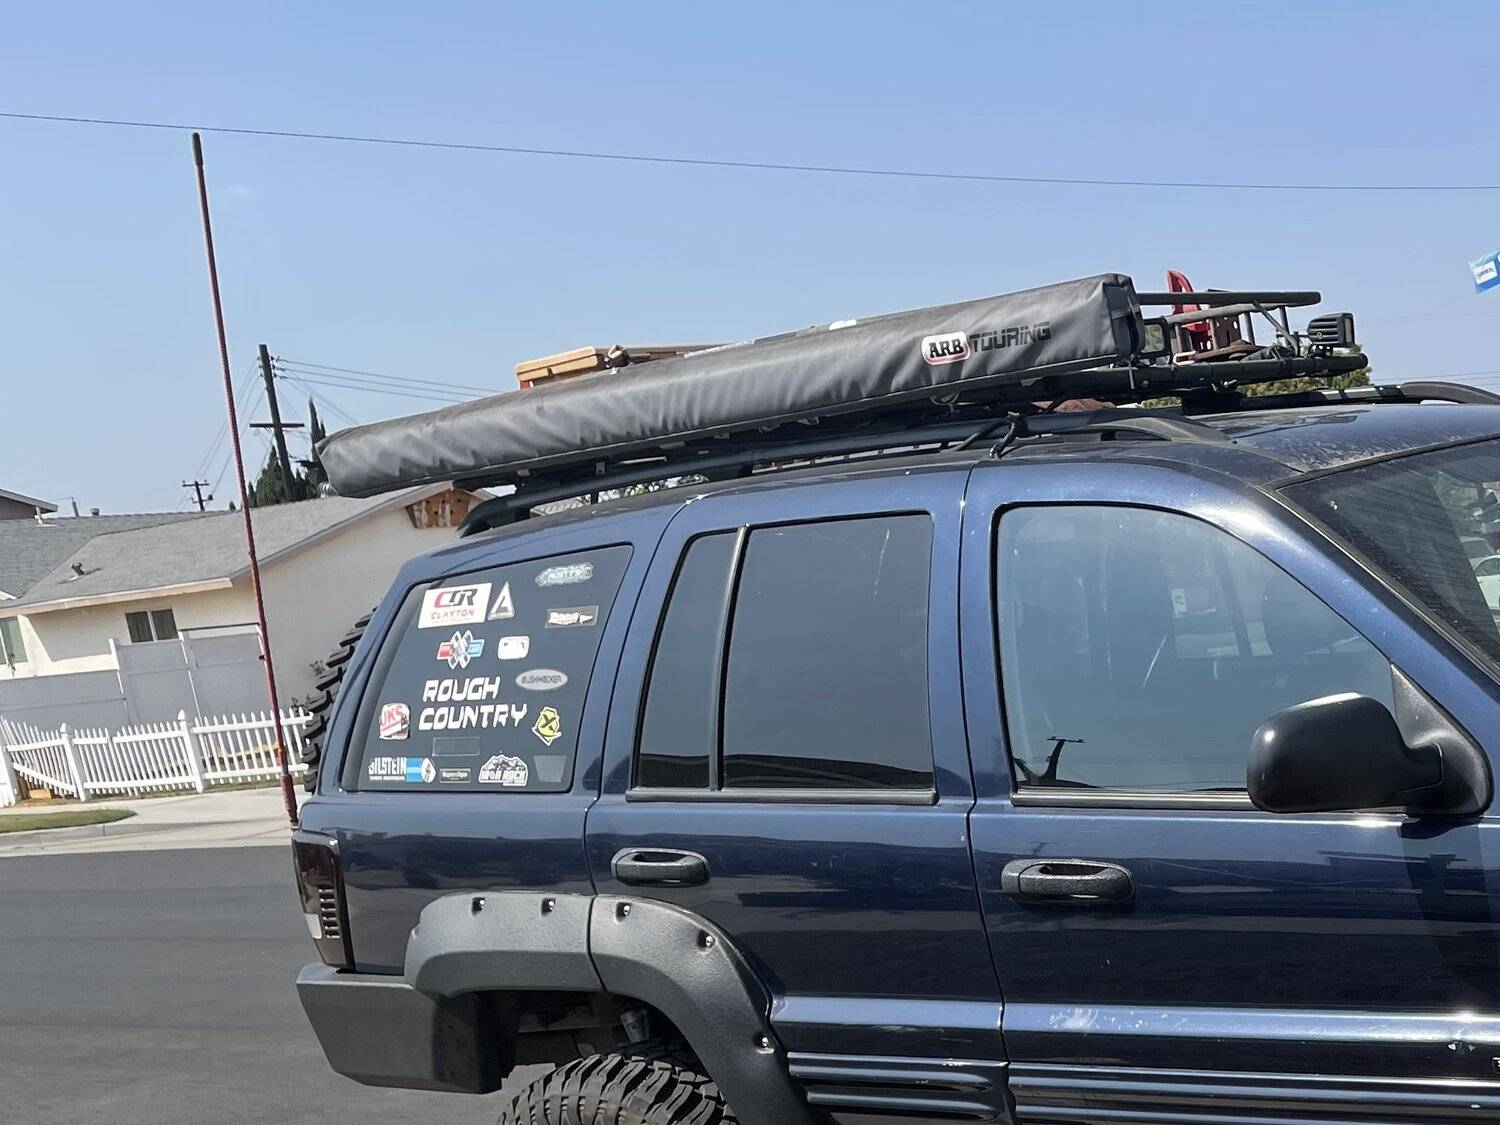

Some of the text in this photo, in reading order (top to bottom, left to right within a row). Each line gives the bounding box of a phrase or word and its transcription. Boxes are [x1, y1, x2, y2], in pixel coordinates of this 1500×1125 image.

[929, 321, 1052, 359] ARB TOURING
[431, 609, 475, 620] CLAYTON
[422, 676, 501, 703] ROUGH
[381, 704, 403, 727] JKS
[418, 703, 528, 731] COUNTRY
[368, 756, 407, 775] BILSTEIN
